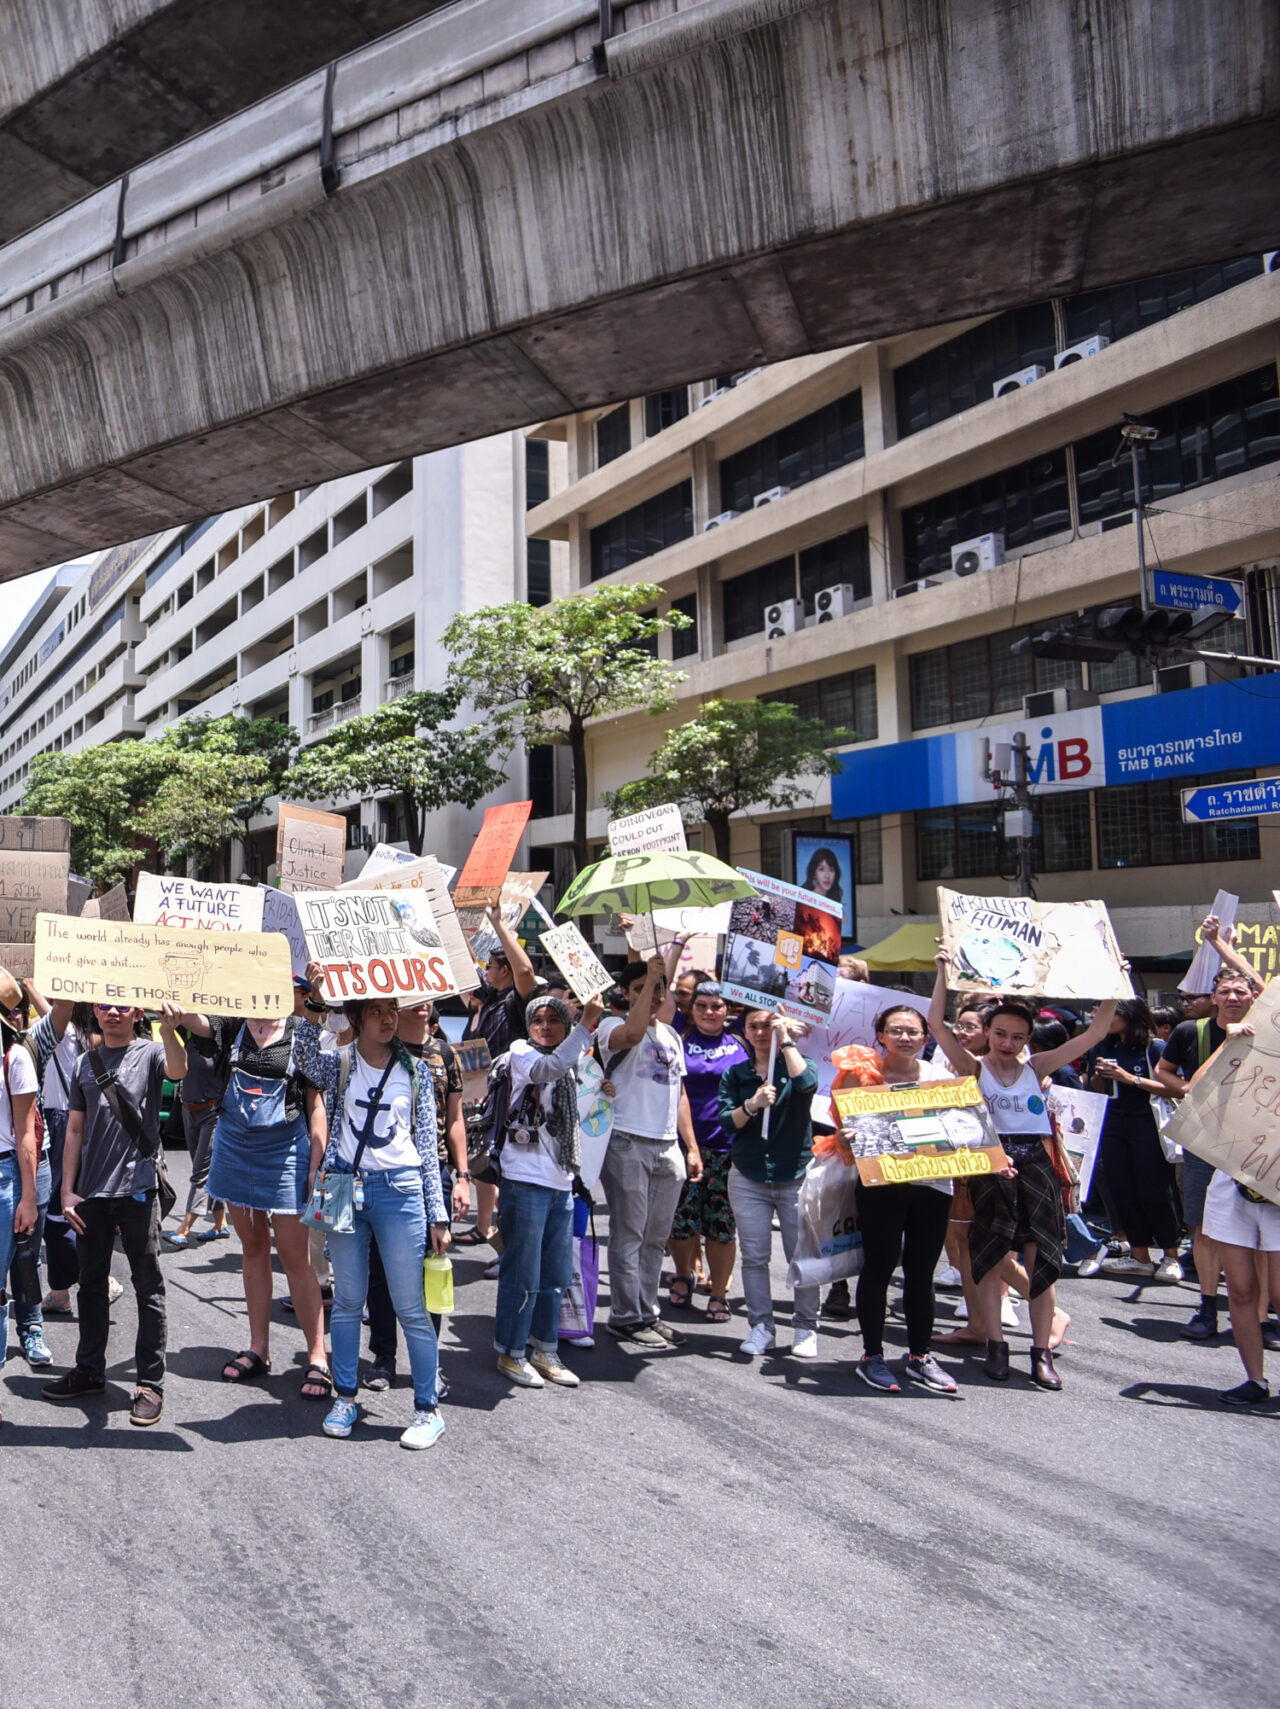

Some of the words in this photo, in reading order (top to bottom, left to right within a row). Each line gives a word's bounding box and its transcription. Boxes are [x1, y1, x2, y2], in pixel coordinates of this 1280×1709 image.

[1118, 729, 1242, 760] ธนาคารทหารไทย
[1119, 757, 1149, 772] TMB
[1153, 752, 1195, 767] BANK
[645, 805, 674, 820] VEGAN
[1208, 803, 1267, 816] Ratchadamri
[612, 830, 644, 846] COULD
[646, 824, 663, 835] CUT
[289, 838, 336, 863] Climate
[285, 861, 328, 880] Justice
[160, 882, 185, 895] WE
[191, 886, 240, 902] WANT
[771, 881, 780, 891] be
[158, 897, 170, 909] A
[175, 899, 241, 918] FUTURE
[345, 895, 390, 927] NOT
[155, 911, 194, 928] ACT
[970, 911, 1043, 948] HUMAN
[44, 919, 69, 940] The
[76, 929, 107, 943] world
[114, 930, 151, 949] already
[154, 934, 170, 947] has
[214, 942, 244, 955] people
[248, 945, 269, 958] who
[46, 951, 71, 964] don't
[77, 956, 96, 968] give
[323, 961, 367, 998] IT'S
[368, 957, 454, 994] OURS.
[52, 977, 98, 995] DON'T
[105, 983, 123, 997] BE
[133, 986, 181, 1001] THOSE
[192, 992, 243, 1010] PEOPLE
[730, 987, 743, 998] We
[744, 992, 757, 1003] ALL
[759, 996, 778, 1007] STOP
[803, 1010, 824, 1024] change
